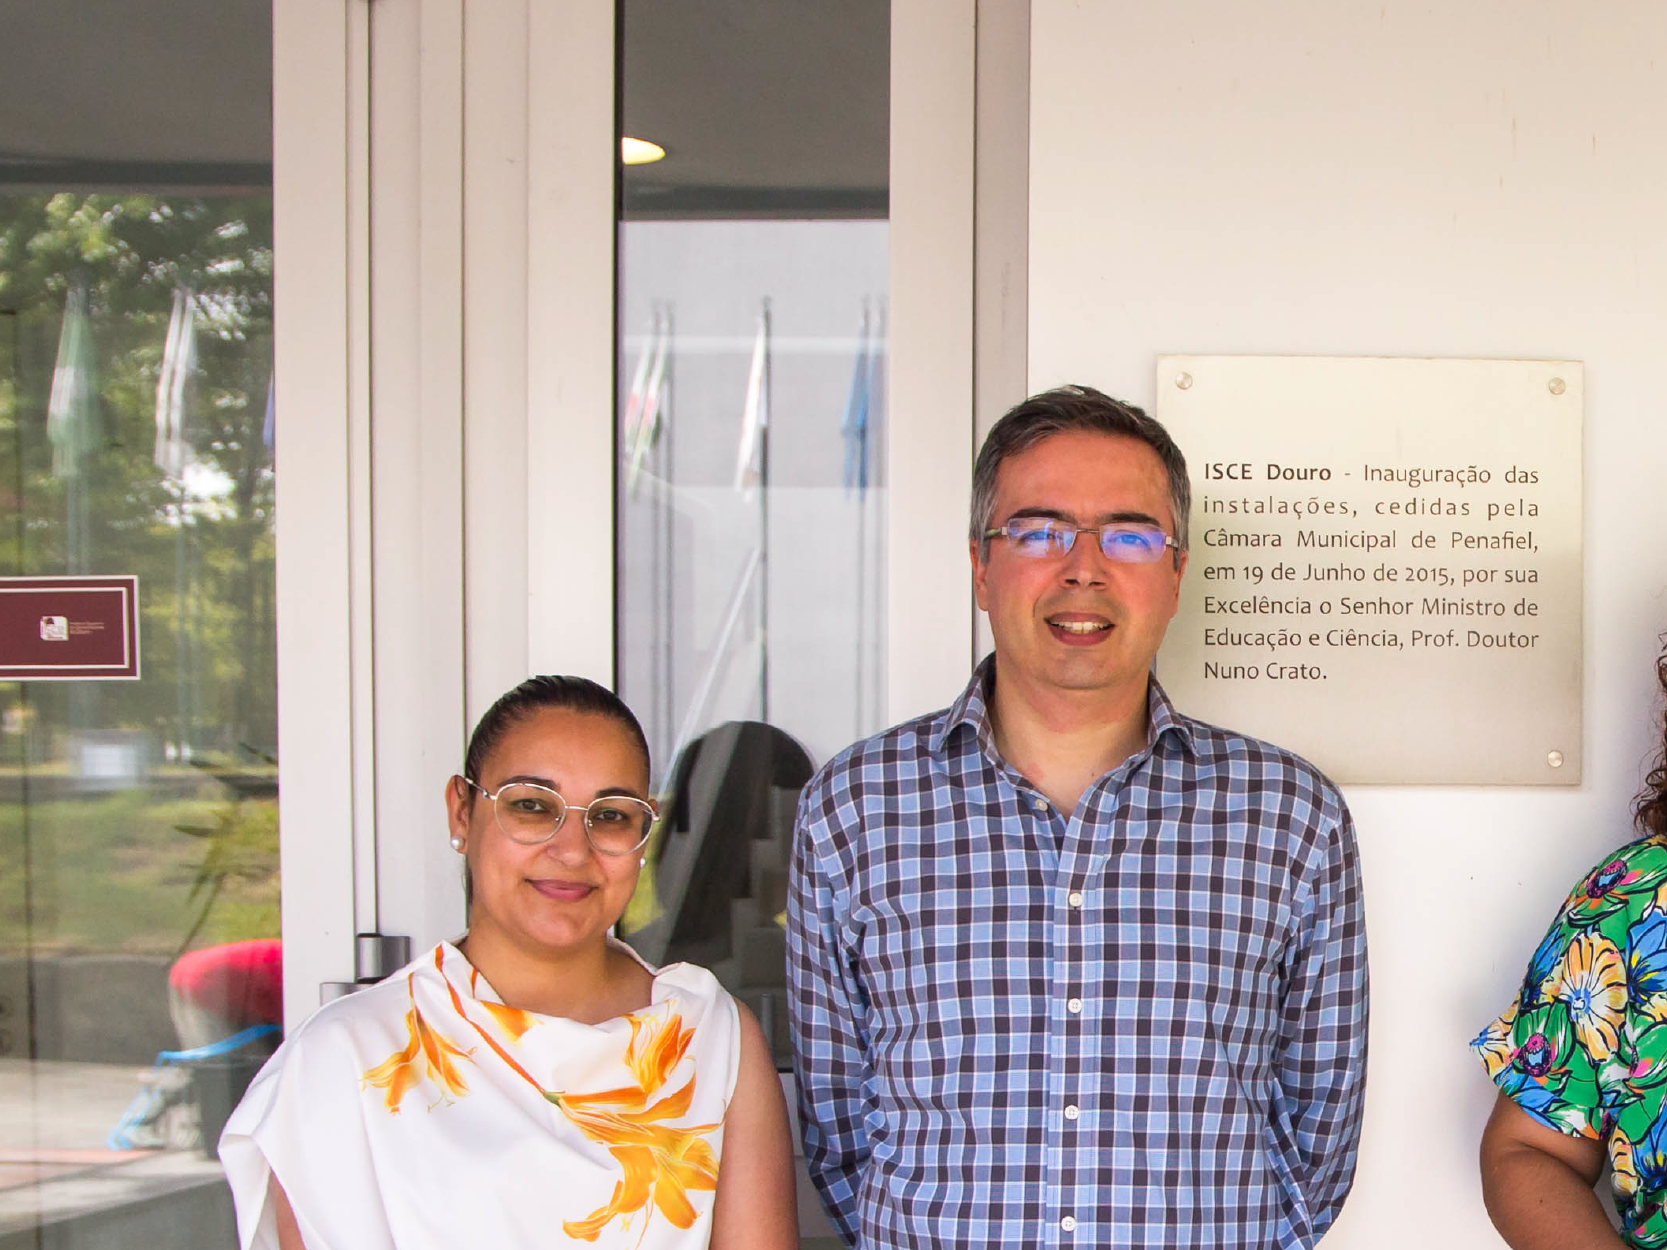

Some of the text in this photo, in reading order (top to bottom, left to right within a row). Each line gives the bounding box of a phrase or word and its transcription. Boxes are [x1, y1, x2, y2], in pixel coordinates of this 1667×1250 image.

[1205, 463, 1253, 480] ISCE
[1267, 463, 1332, 481] Douro
[1364, 464, 1491, 488] Inauguração
[1504, 465, 1539, 484] das
[1204, 495, 1538, 521] instalações, cedidas pela
[1203, 527, 1538, 554] Câmara Municipal de Penafiel,
[1203, 561, 1538, 588] em 19 de Junho de 2015, por sua
[1204, 595, 1538, 617] Excelência o Senhor Ministro de
[1204, 627, 1540, 652] Educação e Ciência, Prof. Doutor
[1204, 661, 1327, 680] Nuno Crato.
